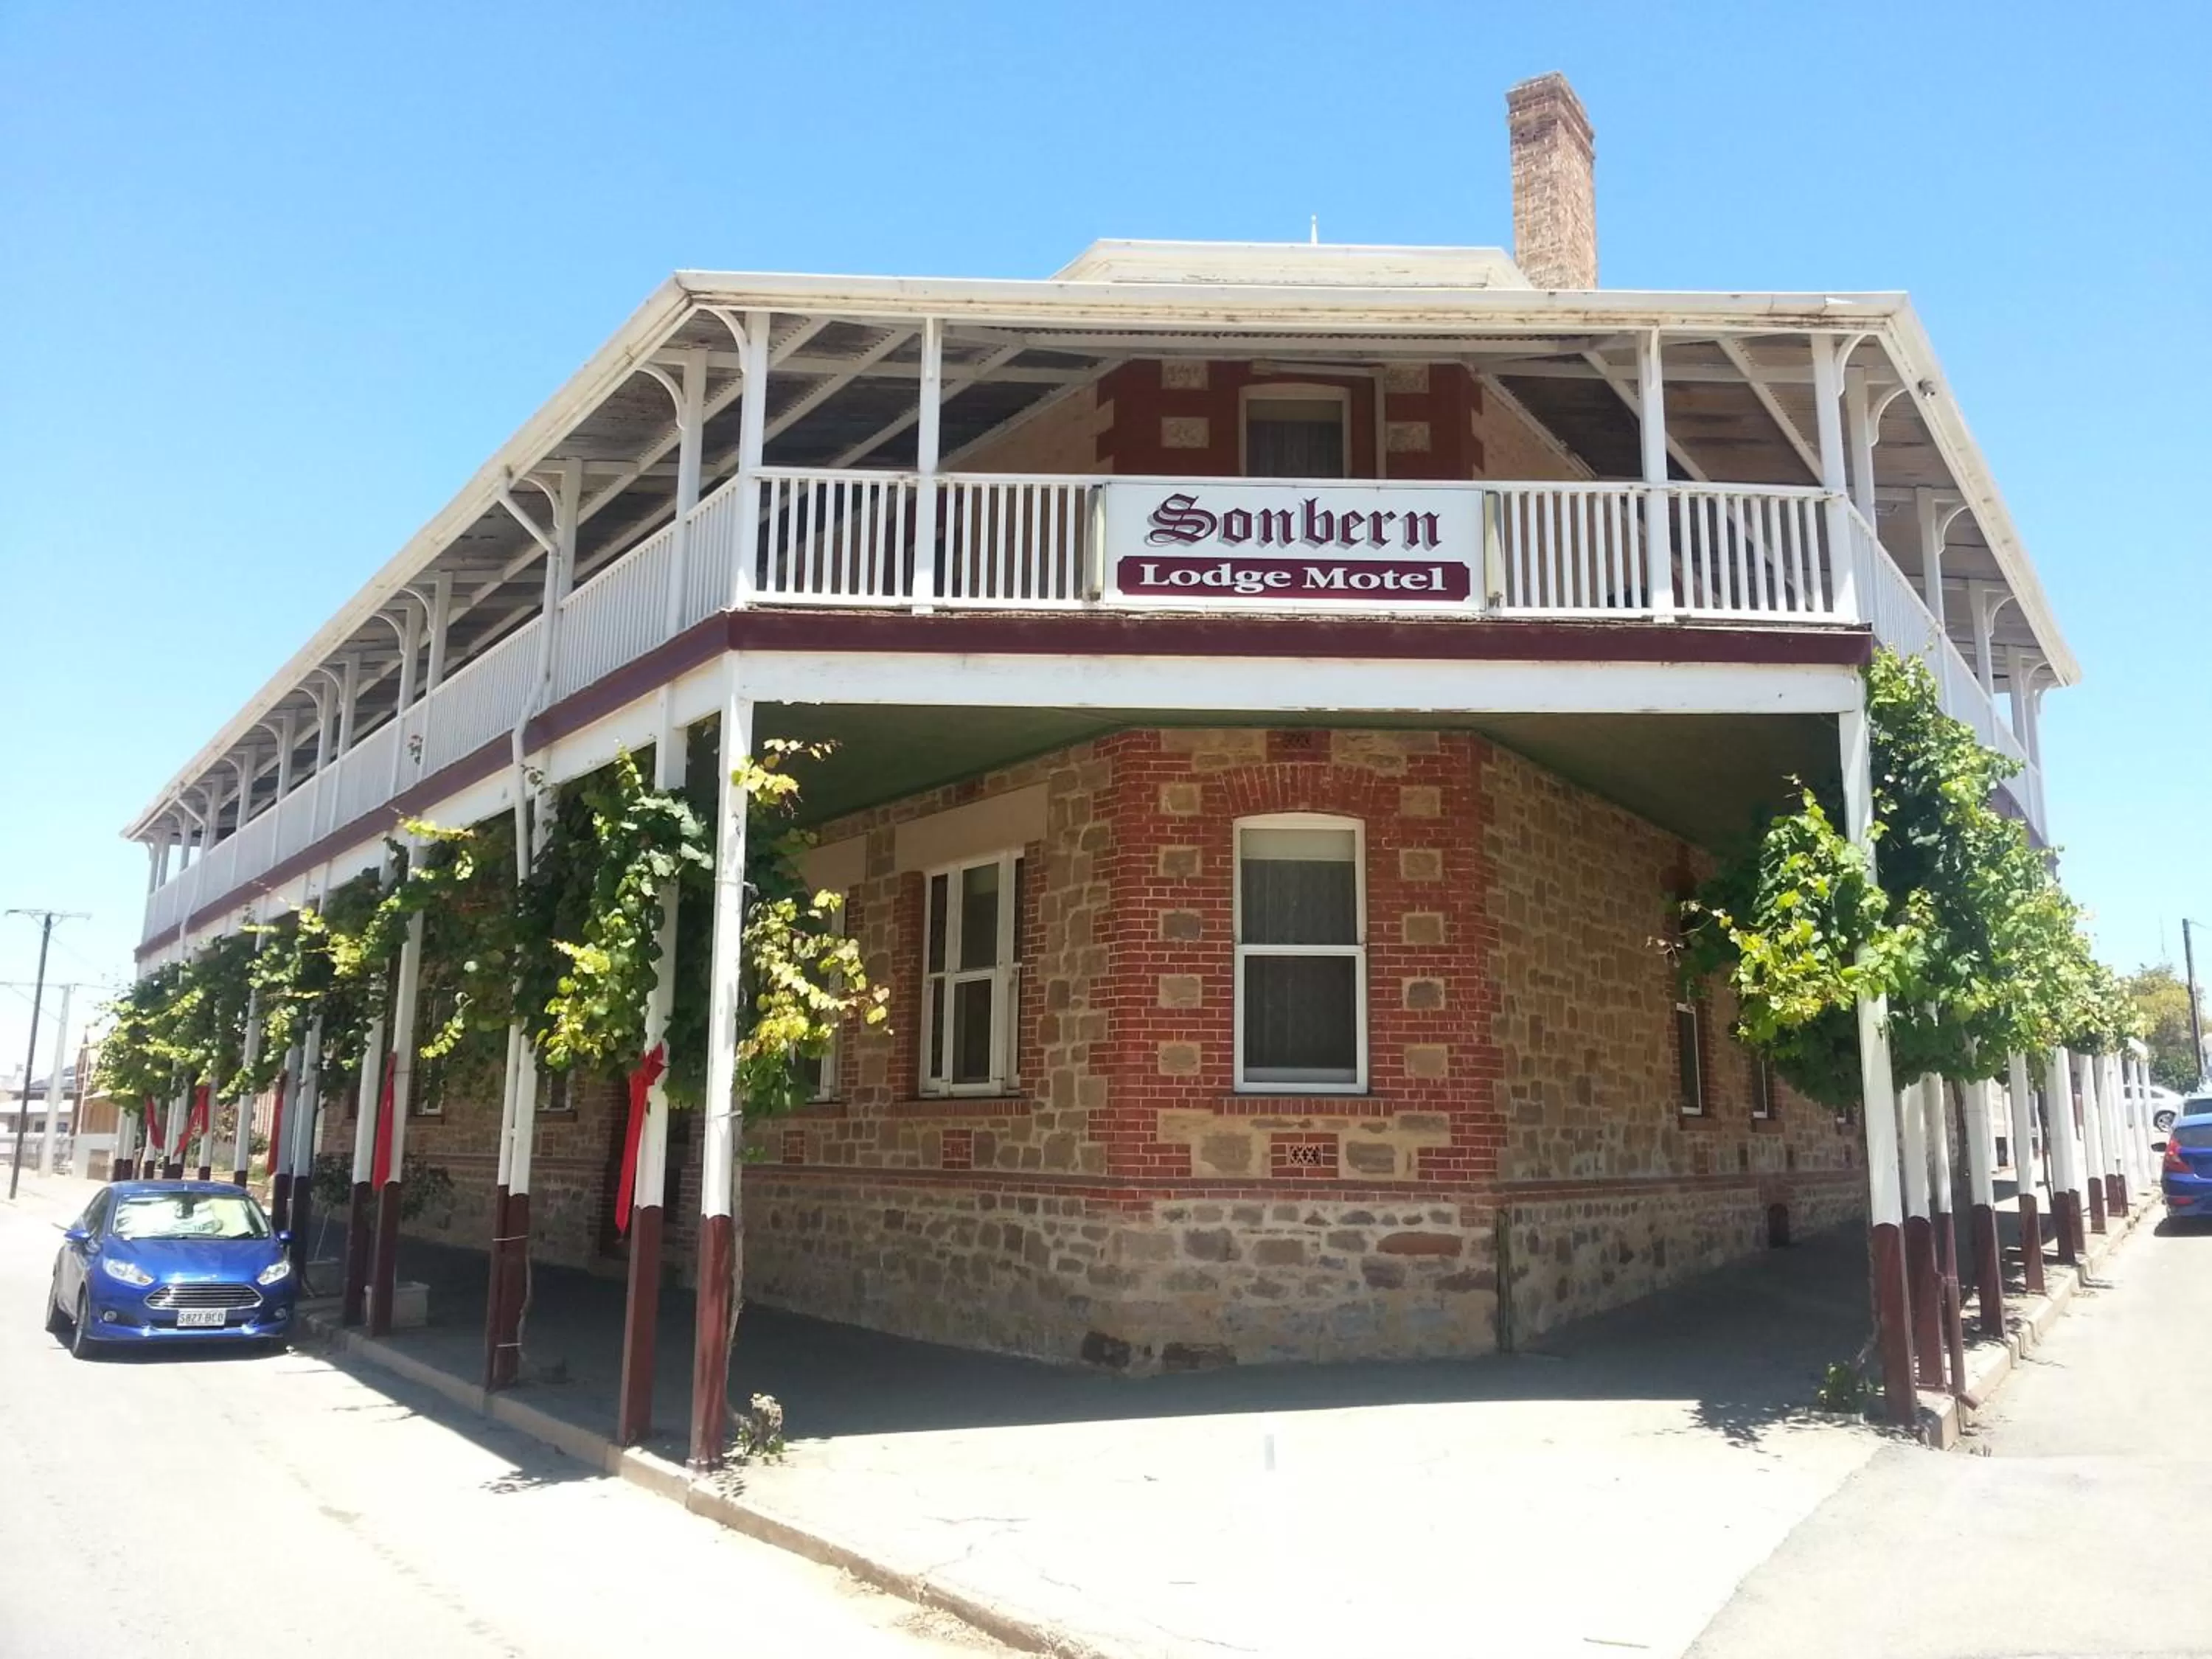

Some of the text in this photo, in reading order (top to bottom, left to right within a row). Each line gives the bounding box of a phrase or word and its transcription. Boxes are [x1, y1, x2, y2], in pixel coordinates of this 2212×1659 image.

[1148, 493, 1442, 549] Sonbern
[1139, 563, 1447, 594] Lodge Motel
